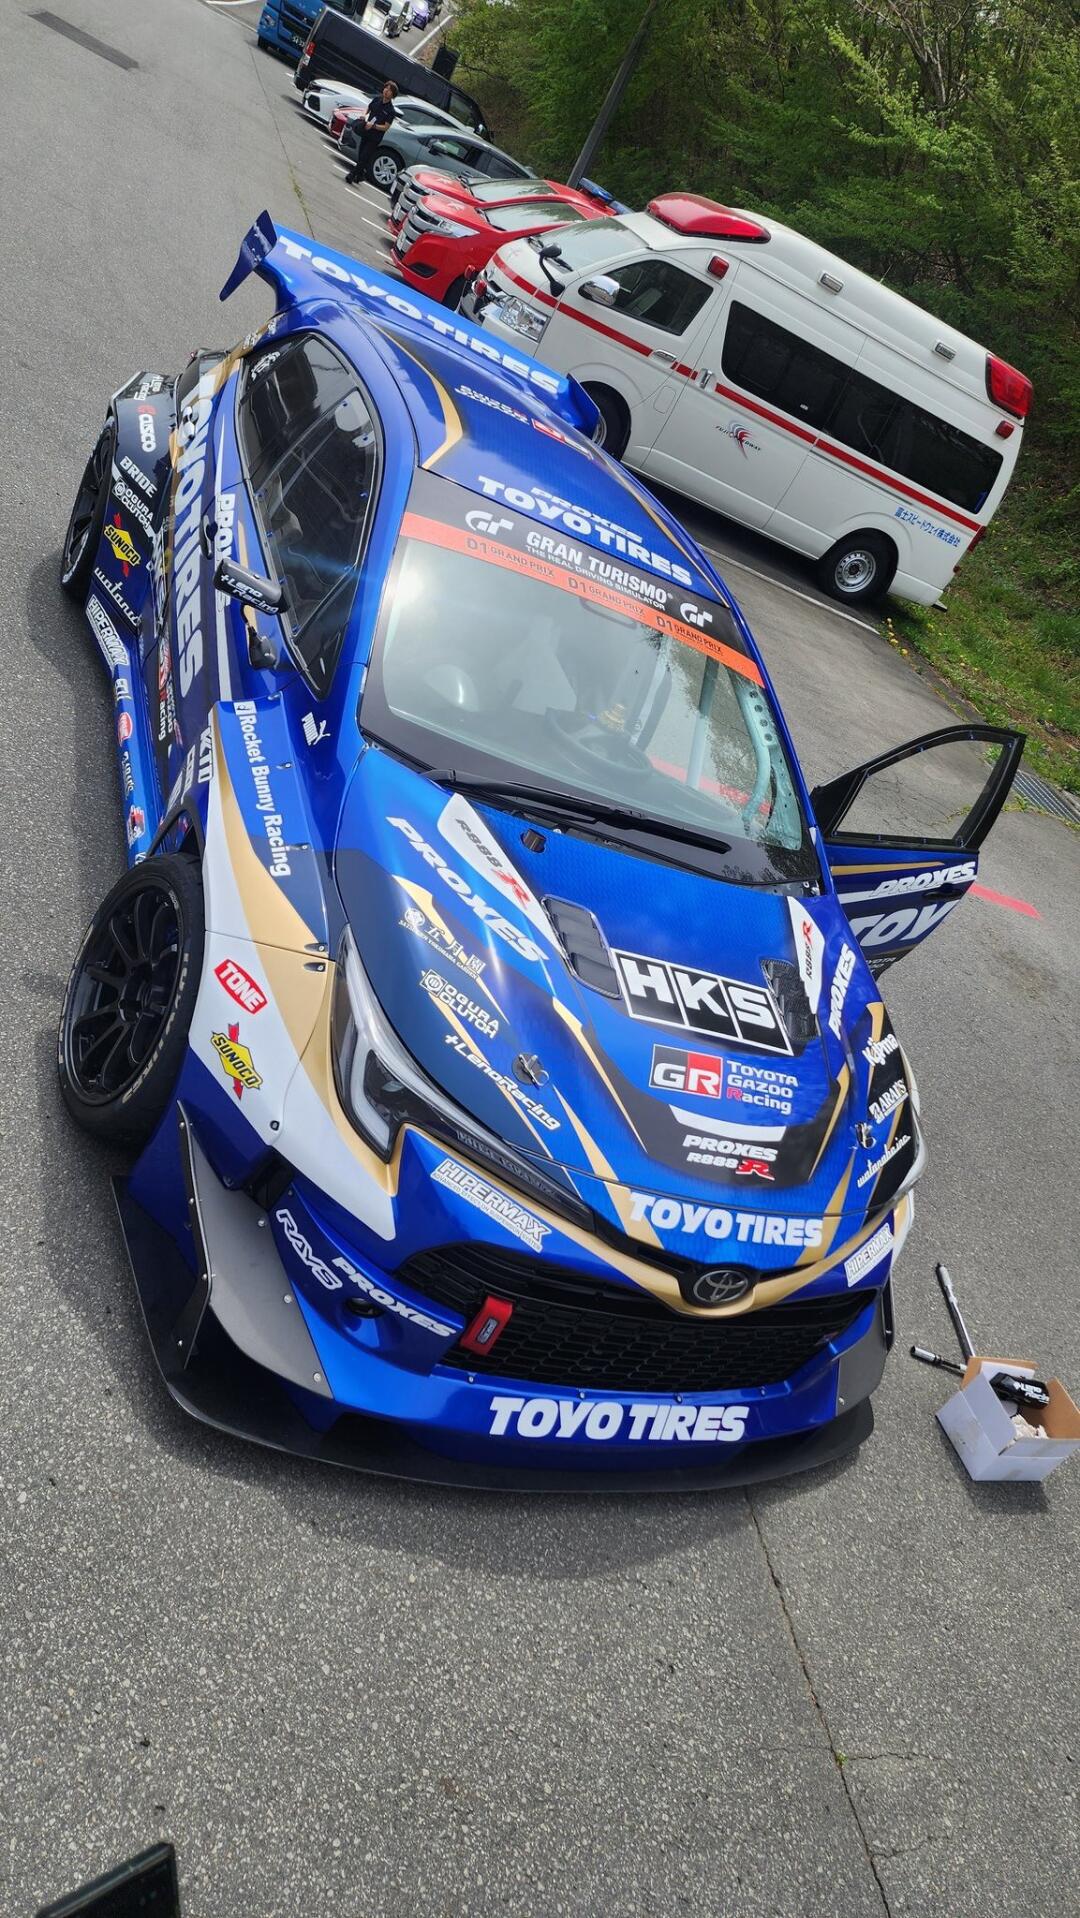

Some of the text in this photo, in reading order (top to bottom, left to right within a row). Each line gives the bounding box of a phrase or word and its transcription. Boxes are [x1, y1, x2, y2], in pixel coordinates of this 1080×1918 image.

[280, 236, 560, 394] TOYO TIRES
[120, 456, 158, 499] BRIDE
[121, 494, 151, 530] CLUTCH
[125, 488, 154, 521] OGURA
[530, 487, 643, 544] PROXES
[105, 526, 140, 565] SUNOCO
[217, 493, 234, 613] PROXS
[478, 475, 693, 586] TOYO TIRES
[526, 531, 583, 566] GRAN
[466, 537, 554, 578] D1 GRAND PRIX
[526, 544, 666, 611] THE REAL DRIVING SIMULATOR
[173, 495, 204, 698] TIRES
[231, 587, 279, 614] Racing
[567, 577, 588, 593] D1
[588, 584, 622, 604] GRAND
[90, 599, 128, 665] HIPERMAX
[655, 616, 724, 656] D1 GRAND PRIX
[239, 714, 292, 878] Rocket Bunny Racing
[386, 816, 550, 961] PROXES
[871, 861, 978, 897] PROXES
[219, 962, 265, 1013] TONE
[444, 984, 500, 1031] OGURA
[620, 957, 777, 1029] HKS
[828, 942, 857, 1041] PROXES
[440, 992, 500, 1040] CLUTCH
[213, 1035, 259, 1086] SUNOCO
[653, 1062, 721, 1096] GR
[726, 1060, 799, 1087] TOYOTA
[726, 1087, 793, 1115] Racing
[727, 1075, 793, 1098] GAZOO
[683, 1134, 779, 1163] PROXES
[437, 1159, 552, 1244] HIPERMAX
[629, 1192, 824, 1248] TOYO TIRES
[276, 1208, 343, 1290] RAYS
[847, 1225, 894, 1278] HIPERMAX
[332, 1256, 457, 1337] PROXES
[489, 1396, 750, 1442] TOYO TIRES
